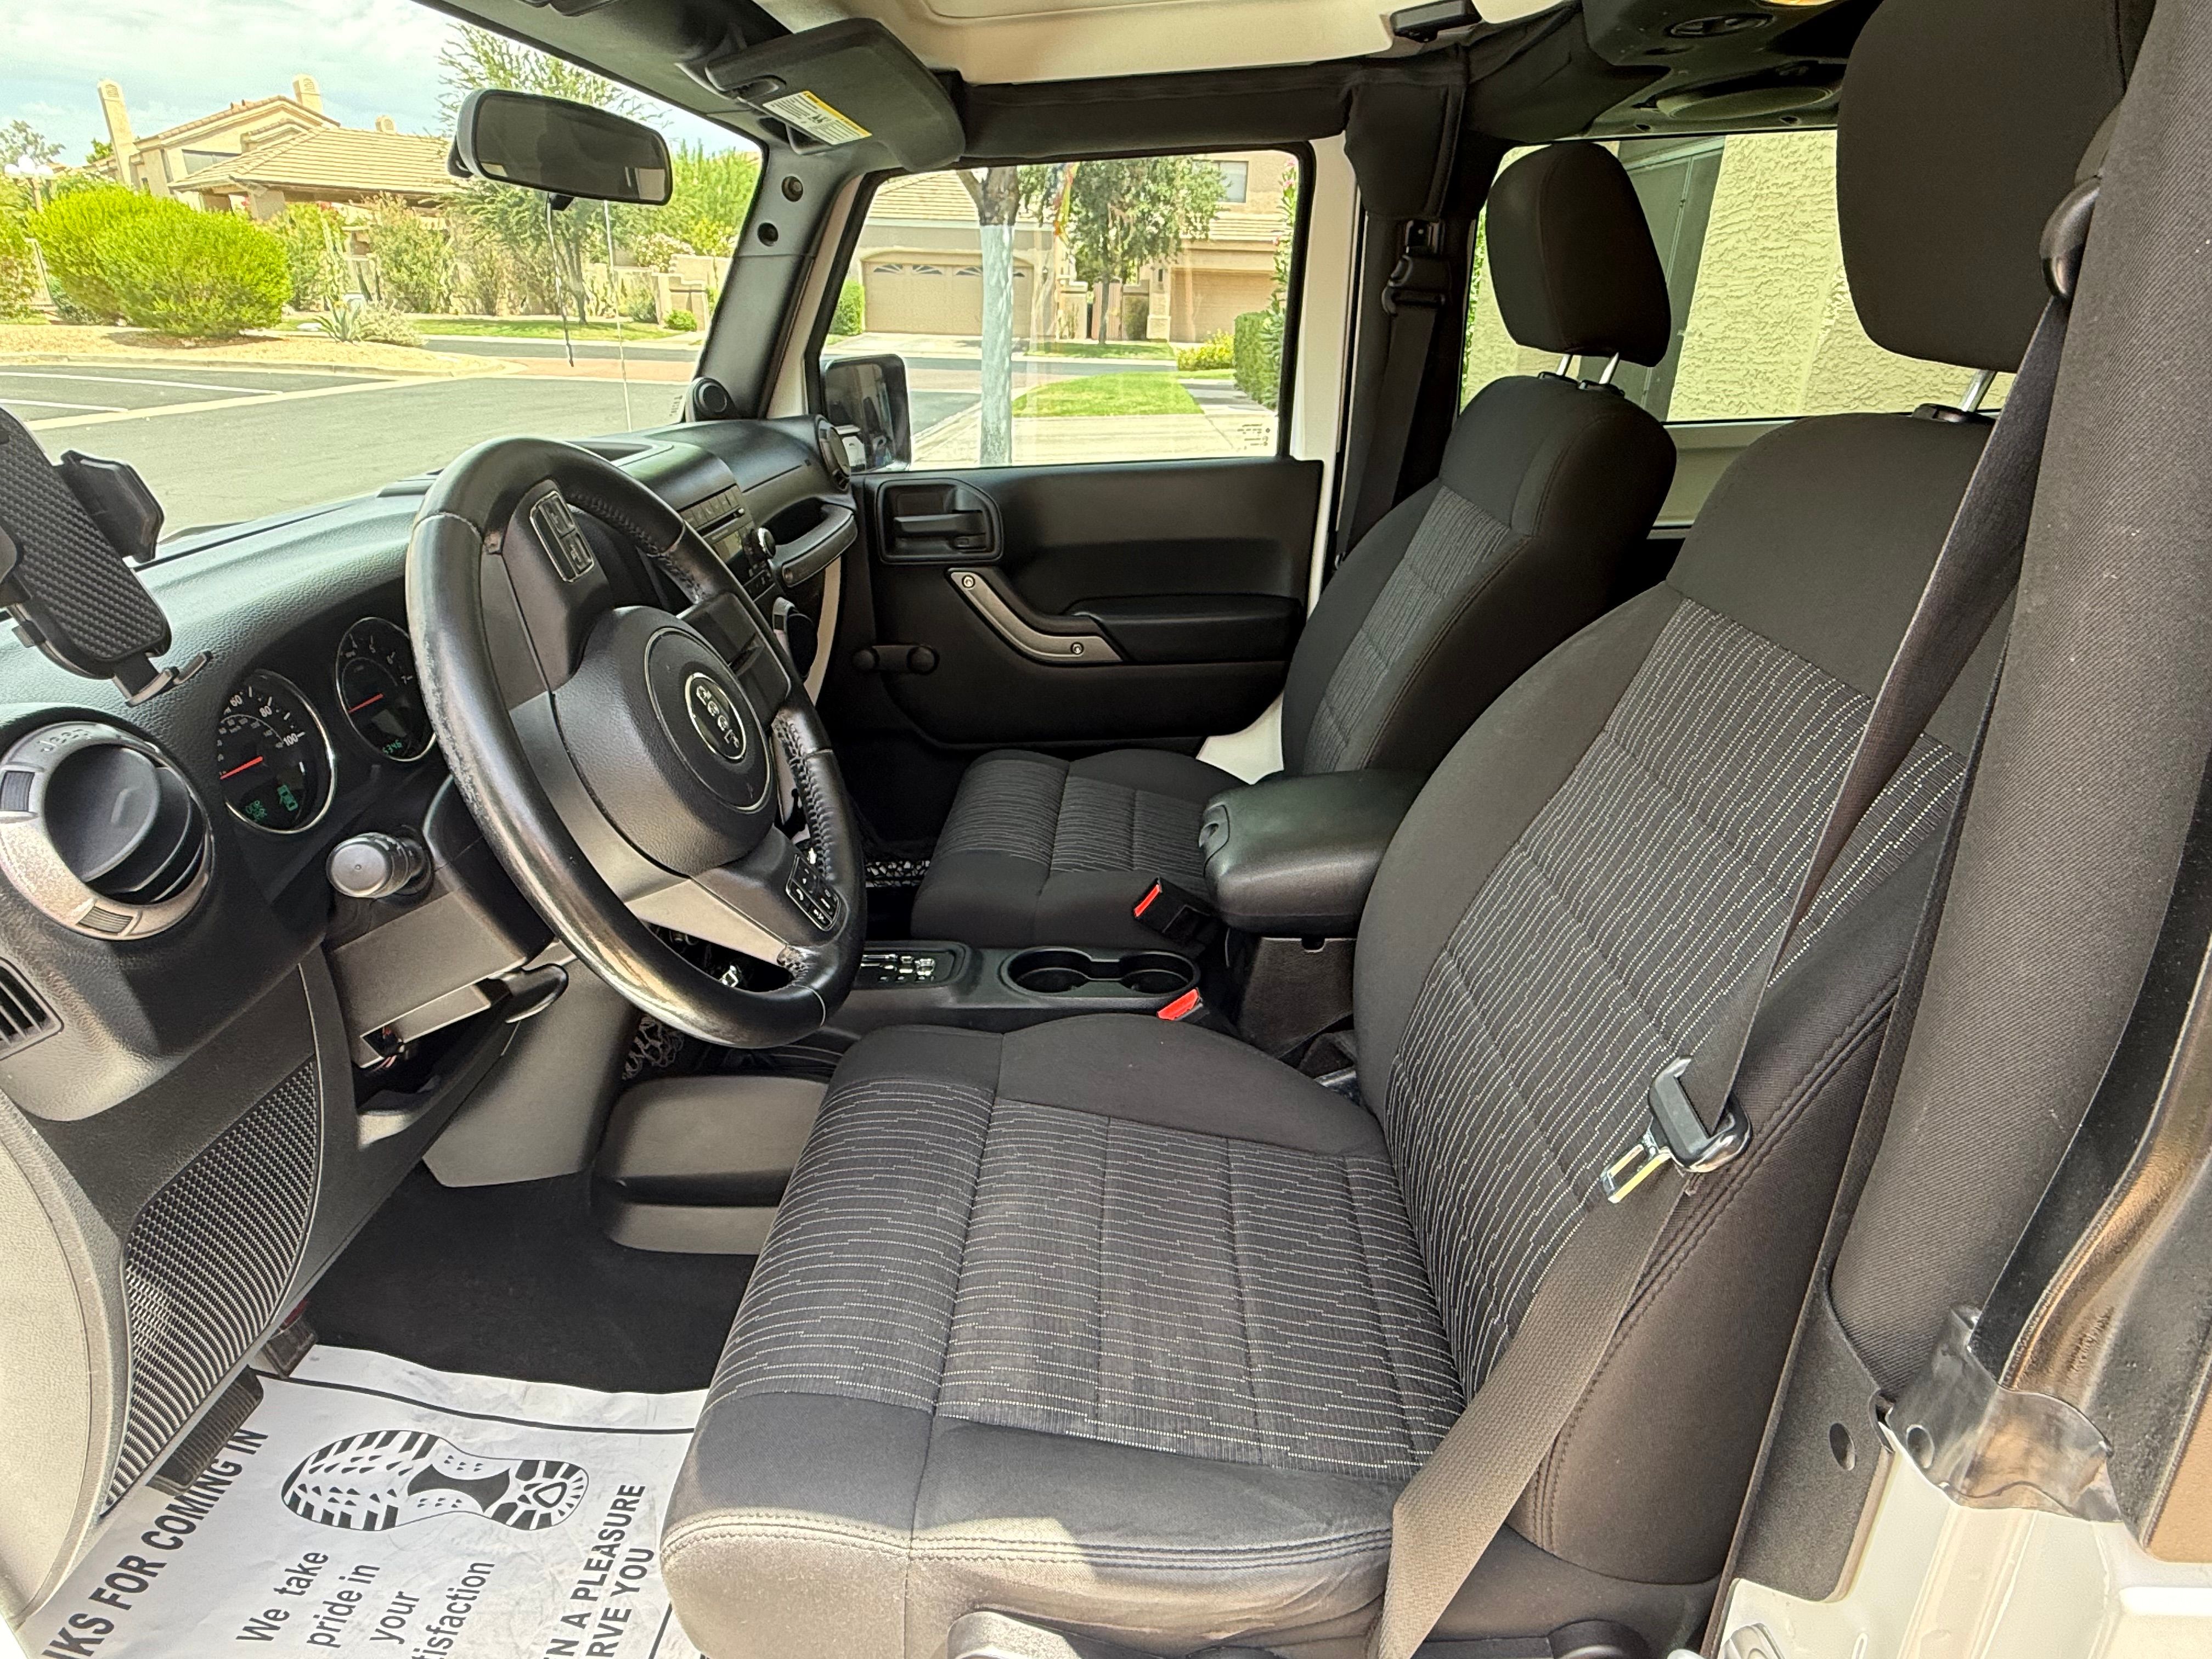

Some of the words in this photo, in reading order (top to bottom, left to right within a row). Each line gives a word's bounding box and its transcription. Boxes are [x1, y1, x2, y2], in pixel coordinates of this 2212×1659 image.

[230, 695, 242, 707] 60
[259, 706, 272, 718] 80
[284, 733, 298, 746] 100
[88, 1555, 167, 1611] FOR
[141, 1458, 242, 1550] COMING
[224, 1429, 269, 1455] IN
[569, 1485, 646, 1602] PLEASURE
[235, 1609, 290, 1641] We
[273, 1552, 329, 1596] take
[610, 1548, 654, 1598] YOU
[306, 1590, 363, 1649] pride
[338, 1565, 381, 1584] in
[369, 1590, 420, 1645] your
[560, 1612, 592, 1629] A
